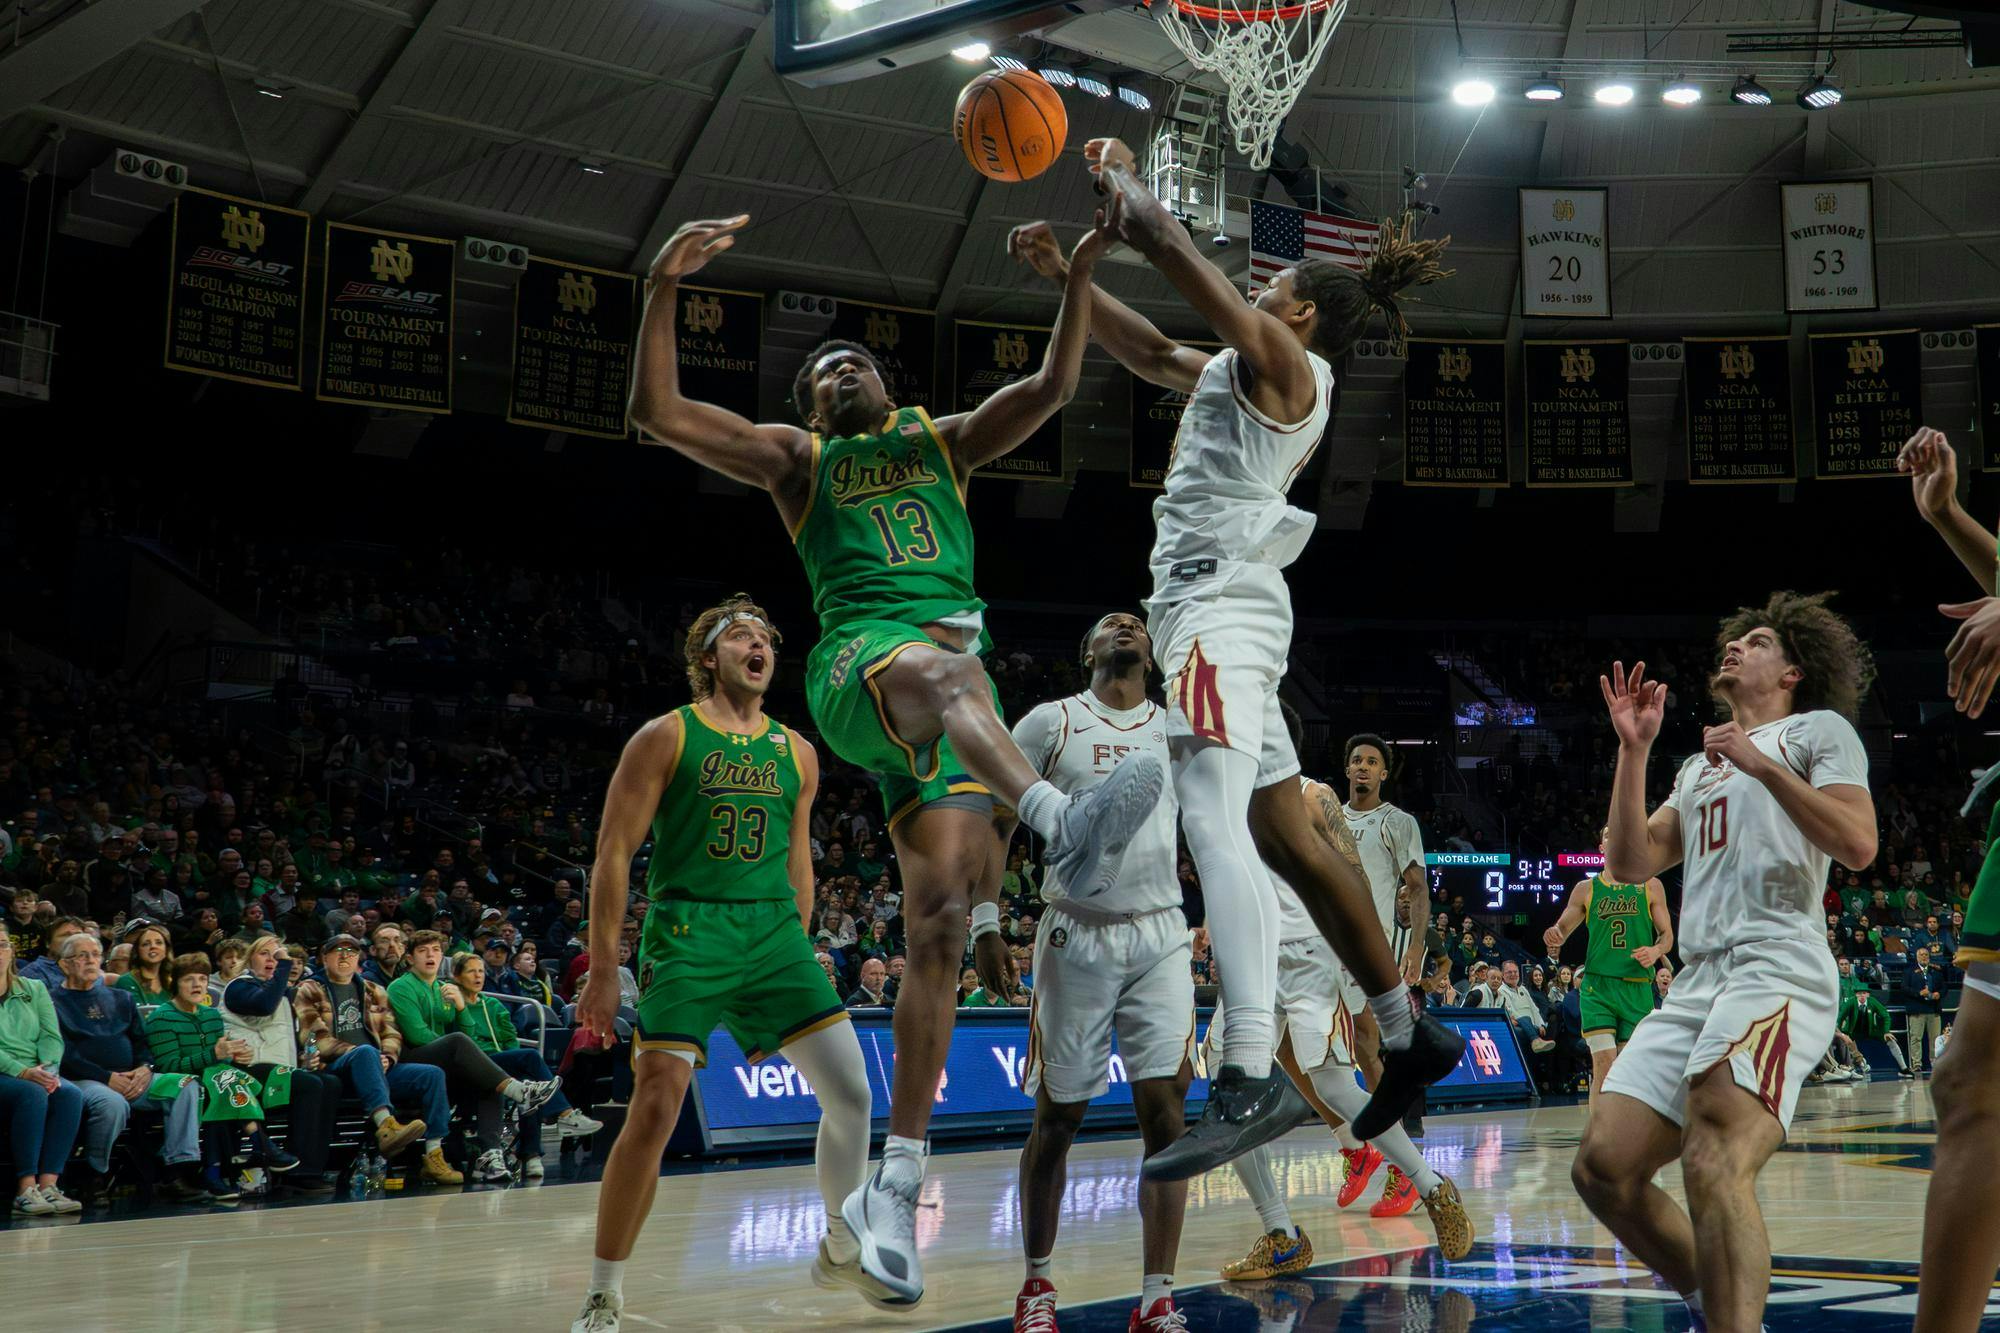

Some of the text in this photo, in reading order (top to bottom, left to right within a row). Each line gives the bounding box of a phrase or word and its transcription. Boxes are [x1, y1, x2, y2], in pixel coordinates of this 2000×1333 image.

[1527, 231, 1601, 247] HAWKINS
[1791, 224, 1866, 240] WHITMORE
[1549, 256, 1581, 282] 20
[1813, 249, 1845, 275] 53
[180, 272, 244, 299] REGULAR
[247, 286, 297, 308] SEASON
[1541, 293, 1561, 302] 1956
[1836, 286, 1858, 296] 1969
[201, 293, 276, 320] CHAMPION
[330, 308, 445, 334] TOURNAMENT
[553, 315, 598, 335] NCAA
[344, 325, 432, 347] CHAMPION
[521, 326, 629, 355] TOURNAMENT
[681, 337, 727, 353] NCAA
[175, 345, 295, 379] WOMEN'S VOLLEYBALL
[326, 378, 445, 403] WOMEN'S VOLLEYBALL
[1435, 387, 1476, 398] NCAA
[1558, 387, 1600, 398] NCAA
[1719, 384, 1760, 395] NCAA
[1845, 379, 1889, 392] NCAA
[1704, 398, 1776, 409] SWEET 16
[1834, 391, 1888, 405] ELITE
[1409, 400, 1502, 413] TOURNAMENT
[1531, 401, 1624, 413] TOURNAMENT
[1828, 408, 1911, 424] 1953 1954
[1828, 426, 1861, 440] 1958
[1829, 440, 1902, 456] 1979 201
[995, 458, 1052, 472] BASKETBALL
[1416, 466, 1498, 479] MEN'S BASKETBALL
[1537, 466, 1624, 479] MEN'S BASKETBALL
[1700, 464, 1785, 476] MEN'S BASKETBALL
[1827, 459, 1856, 472] MEN'S
[831, 448, 938, 500] Irish
[870, 499, 940, 567] 13
[699, 750, 783, 794] Irish
[707, 803, 768, 862] 33
[1698, 796, 1728, 857] 10
[1437, 855, 1499, 864] NOTRE DAME
[1518, 860, 1552, 879] 9:12
[1485, 871, 1504, 907] 9
[1536, 892, 1540, 904] 1
[1597, 895, 1640, 918] Irish
[1611, 919, 1627, 949] 2
